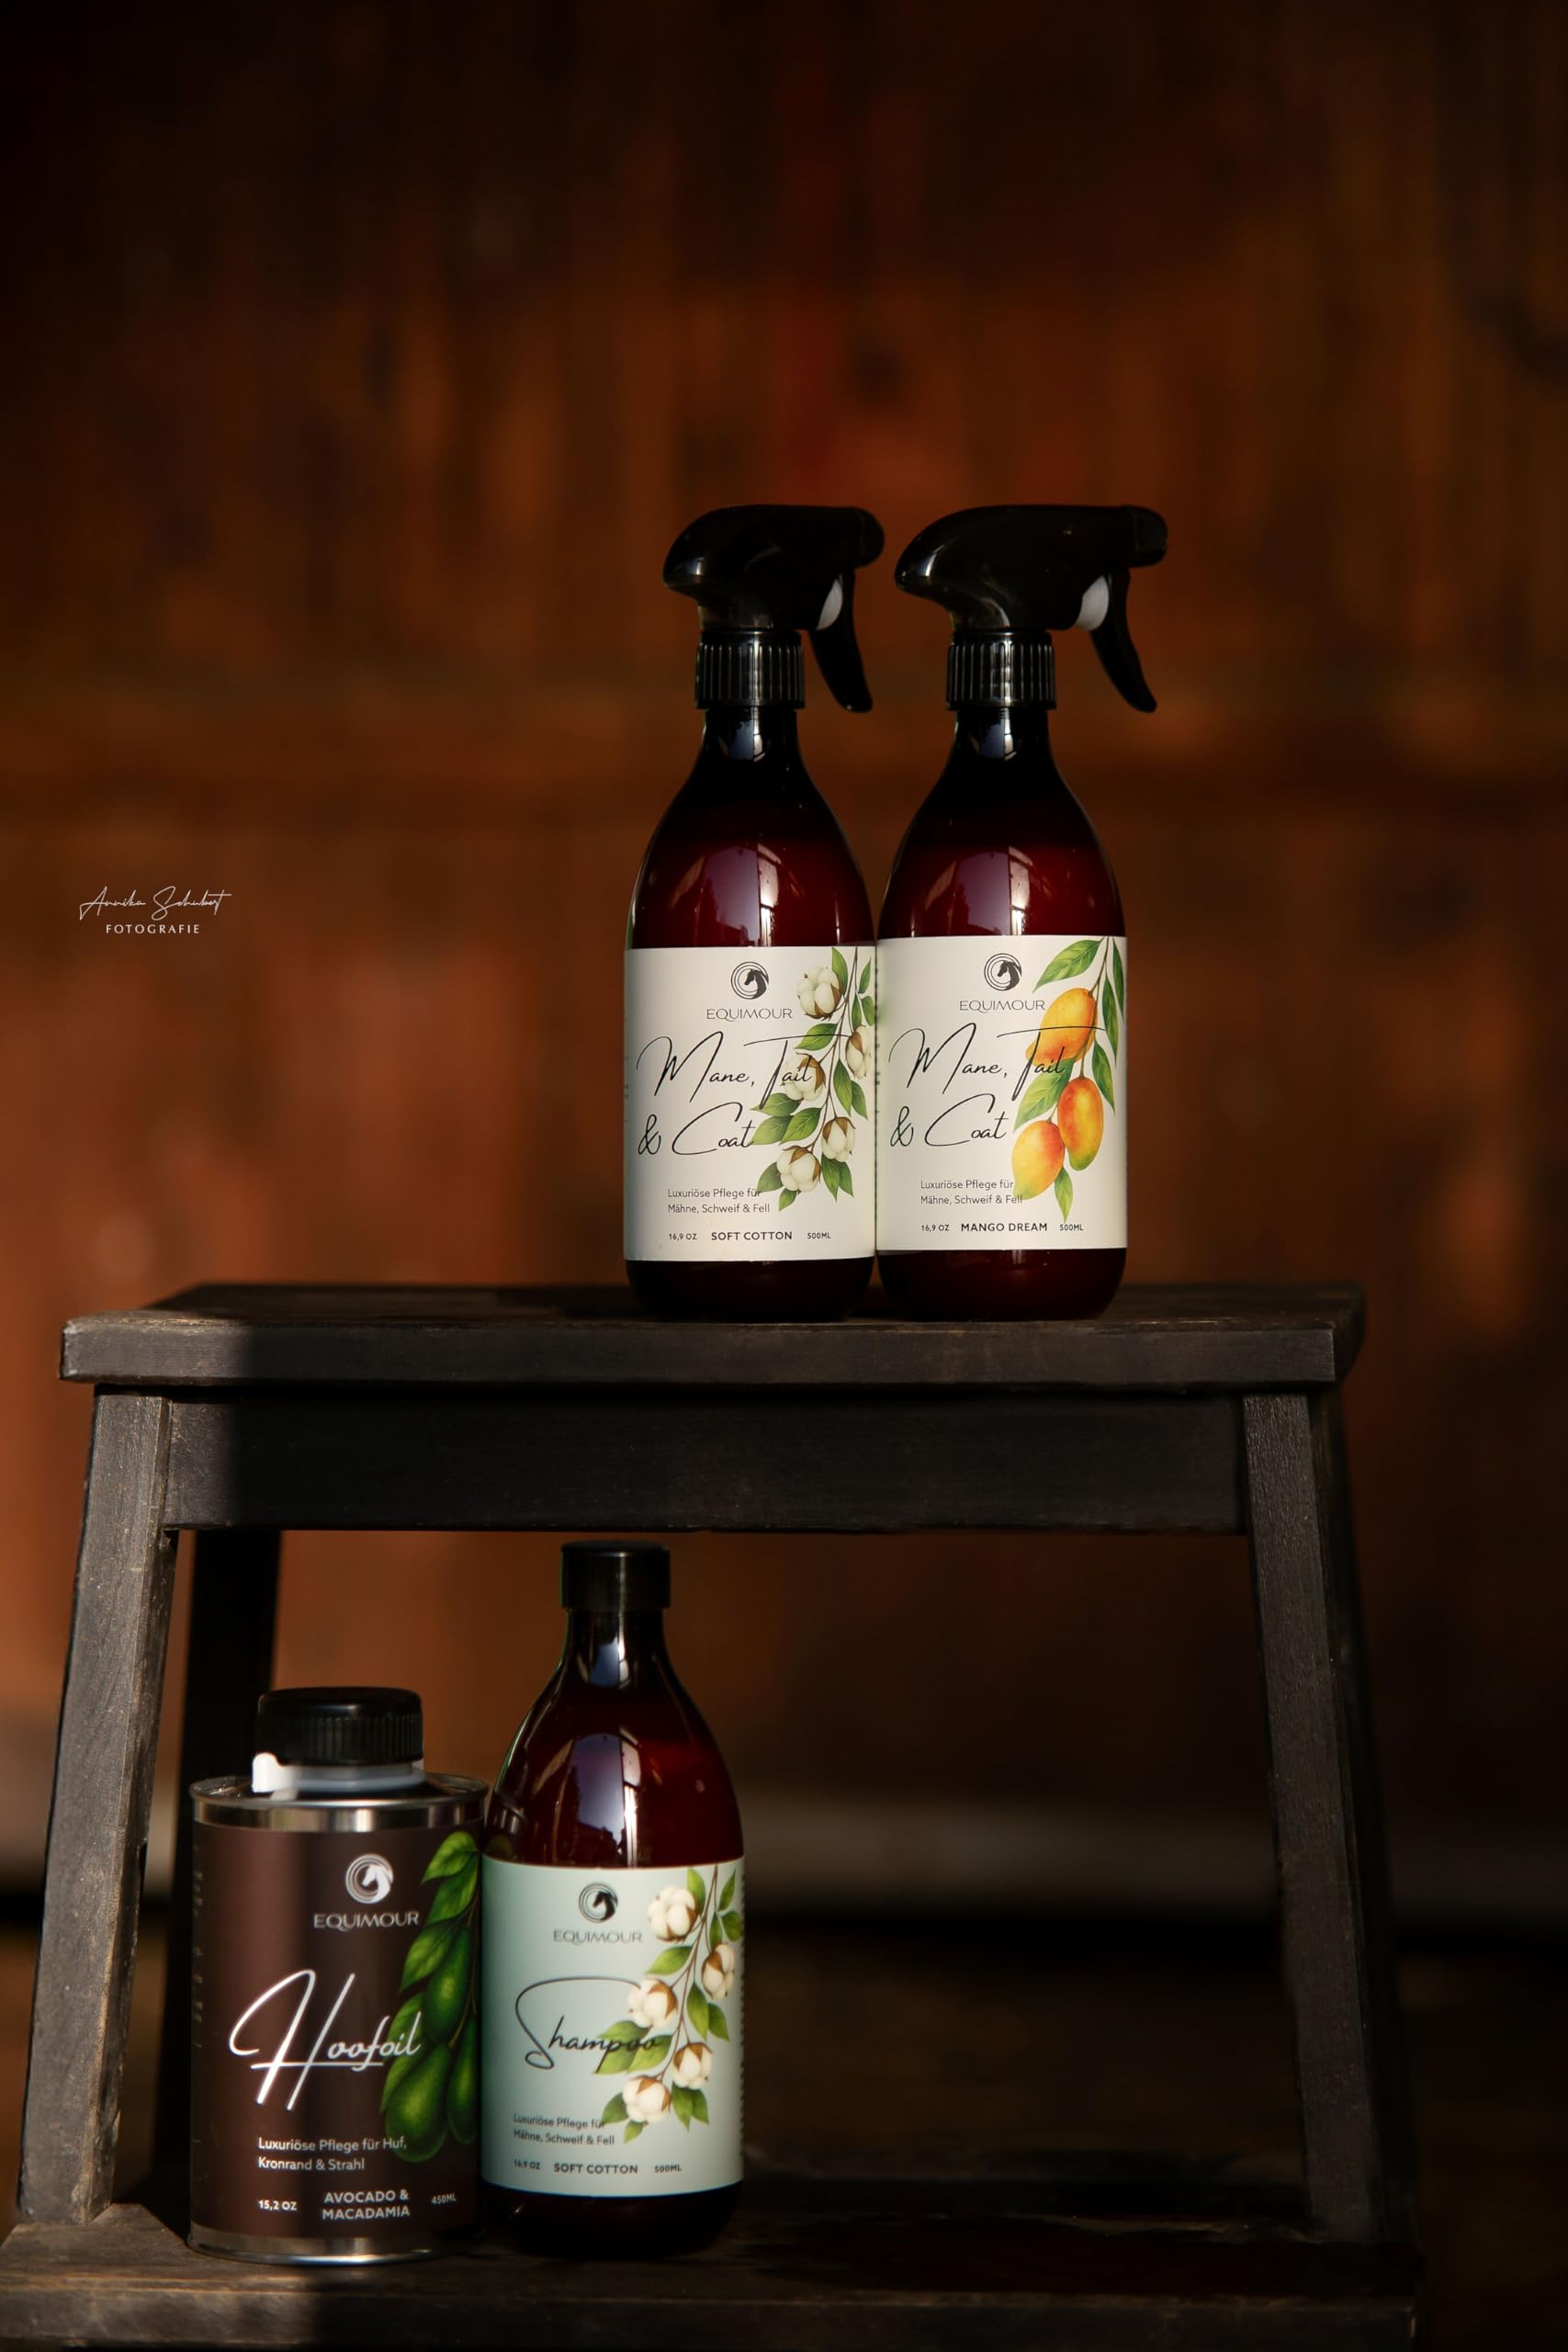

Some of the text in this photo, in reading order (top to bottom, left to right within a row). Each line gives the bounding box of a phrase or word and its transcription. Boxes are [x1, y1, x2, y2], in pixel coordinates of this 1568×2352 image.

[959, 1000, 1046, 1013] EQUIMOUR
[706, 1008, 793, 1022] EQUIMOUR
[888, 1023, 1106, 1102] Mane, Tail
[637, 1031, 755, 1102] Mane,
[743, 1034, 852, 1110] Tail
[889, 1093, 1010, 1147] & Coat
[637, 1102, 757, 1156] & Coat
[920, 1179, 1013, 1191] Luxuriöse Pflege für
[668, 1188, 761, 1199] Luxuriöse Pflege für
[920, 1193, 1022, 1205] Mähne, Schweif & Fell
[668, 1203, 770, 1215] Mähne, Schweif & Fell
[961, 1223, 1005, 1232] MANGO
[1009, 1223, 1048, 1231] DREAM
[669, 1233, 683, 1241] 16,9
[711, 1231, 741, 1240] SOFT
[743, 1231, 793, 1240] COTTON
[314, 1911, 420, 1931] EQUIMOUR
[553, 1929, 643, 1945] EQUIMOUR
[515, 1975, 661, 2075] Shampoo
[229, 1969, 422, 2110] Hoofoil
[513, 2112, 605, 2130] Luxuriöse Pflege für
[258, 2136, 407, 2154] Luxuriöse Pflege für Huf,
[546, 2132, 583, 2144] Schweif
[586, 2135, 593, 2145] &
[597, 2135, 615, 2145] Fell
[258, 2156, 366, 2170] Kronrand & Strahl
[529, 2161, 541, 2170] OZ
[554, 2163, 583, 2173] SOFT
[586, 2165, 637, 2175] COTTON
[654, 2164, 682, 2173] 500ML
[323, 2188, 409, 2203] AVOCADO &
[431, 2193, 457, 2205] 450ML
[258, 2199, 298, 2211] 15,2 OZ
[322, 2206, 411, 2220] MACADAMIA
